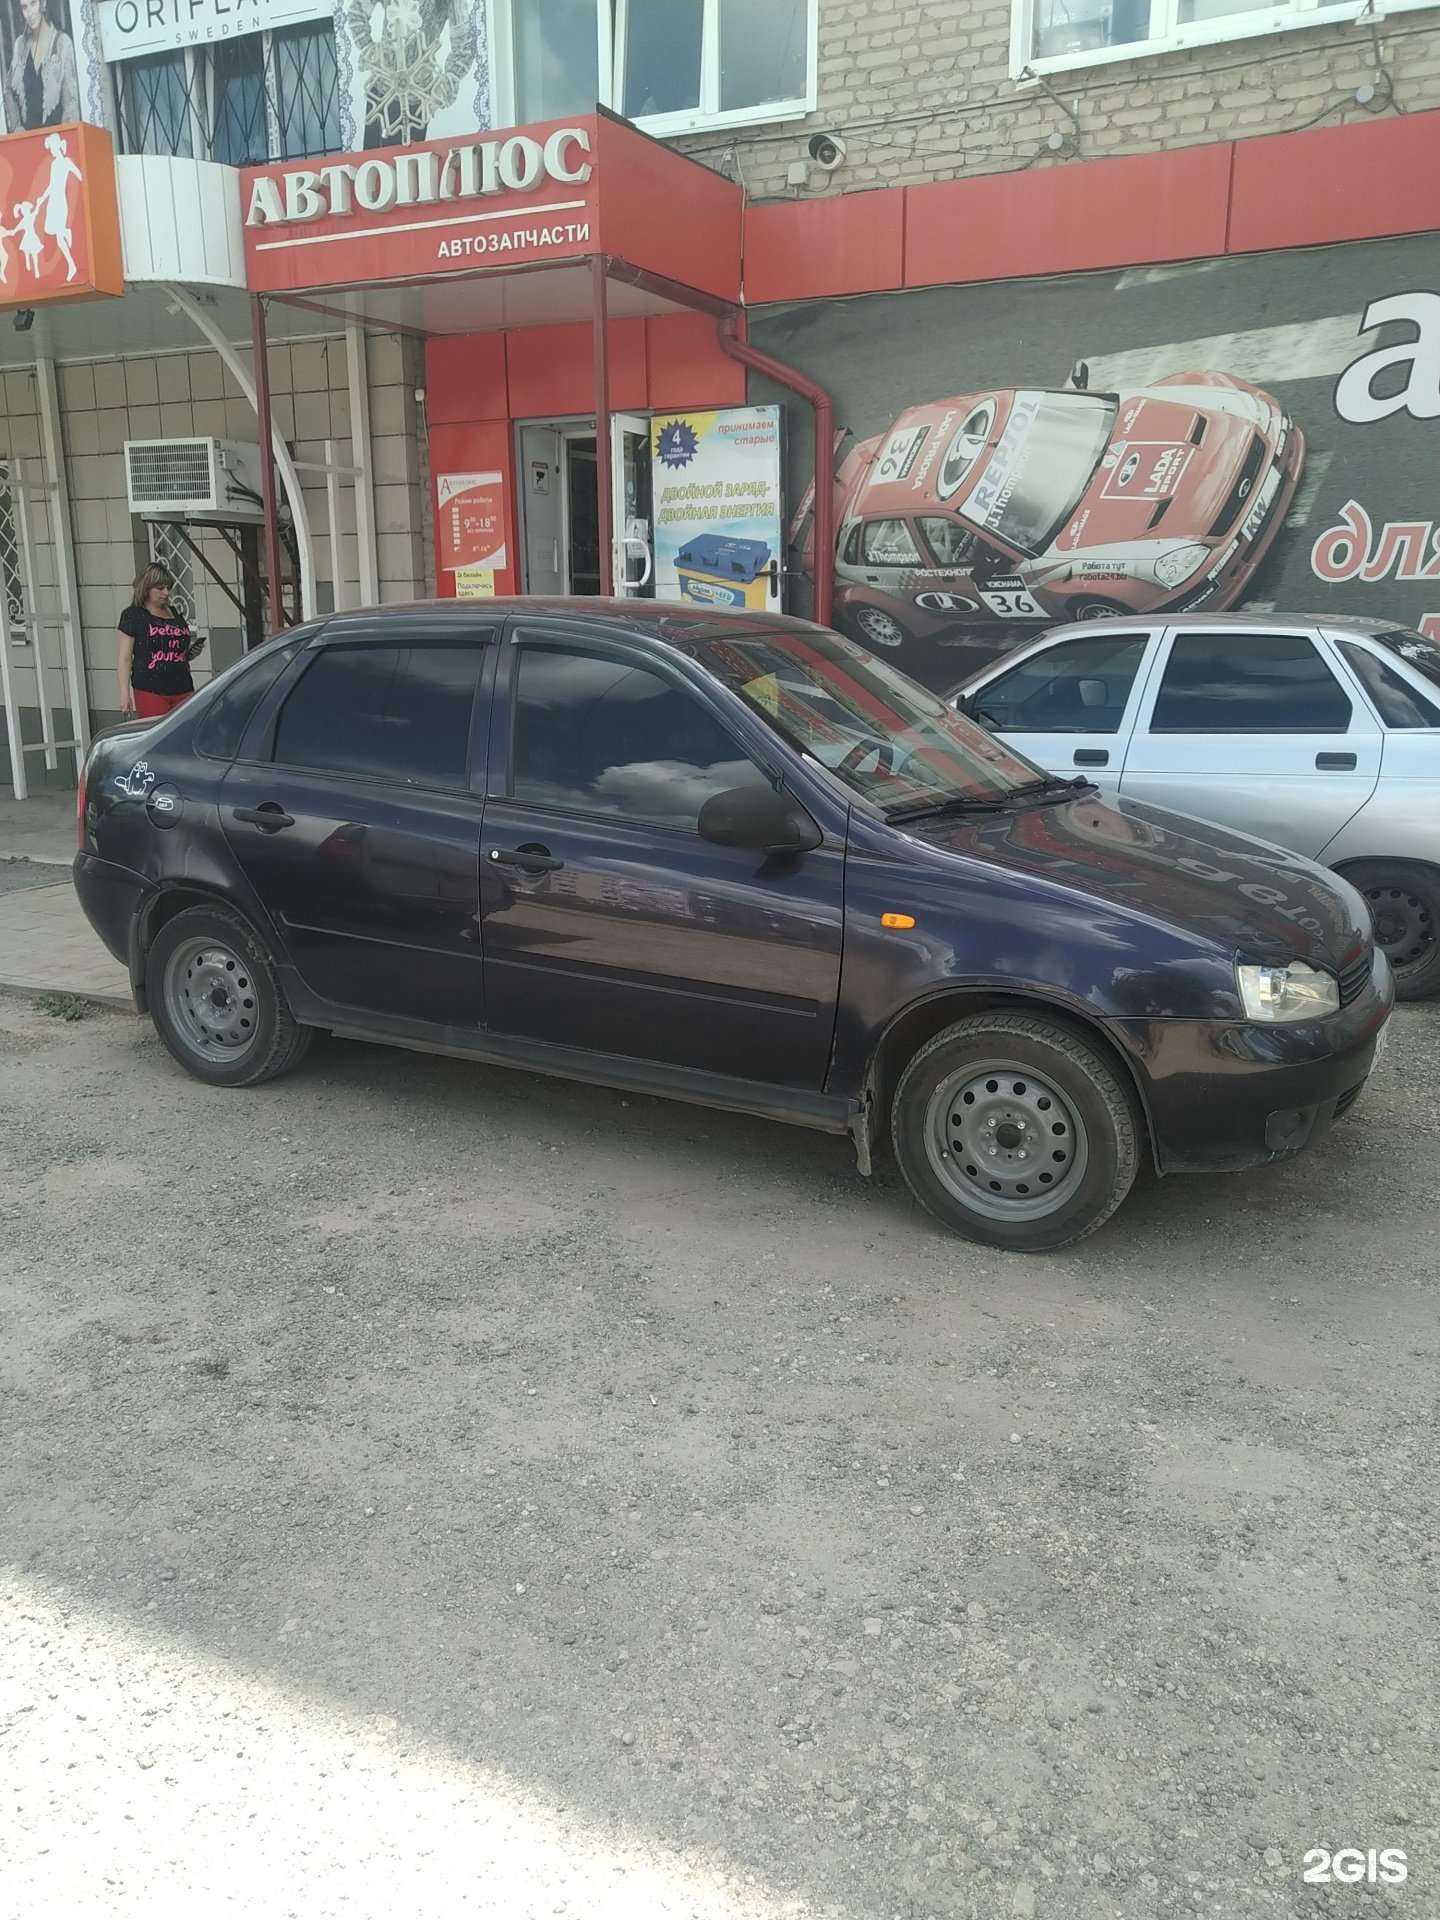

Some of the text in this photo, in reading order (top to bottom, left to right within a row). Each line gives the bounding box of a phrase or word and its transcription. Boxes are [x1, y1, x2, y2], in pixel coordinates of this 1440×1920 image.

[175, 16, 260, 43] SWEDEN
[245, 128, 593, 227] АВТОПЛЮС
[437, 223, 590, 258] АВТОЗАПЧАСТИ
[672, 429, 681, 446] 4
[718, 421, 774, 434] принимаем
[880, 438, 911, 476] 36
[1143, 448, 1178, 493] LADA
[1159, 448, 1185, 493] SPORT
[660, 480, 723, 504] ДВОЙНОЙ
[1245, 496, 1269, 536] KW
[1311, 500, 1440, 583] дл
[1082, 561, 1111, 570] Работа
[991, 594, 1035, 613] 36
[168, 638, 180, 649] in
